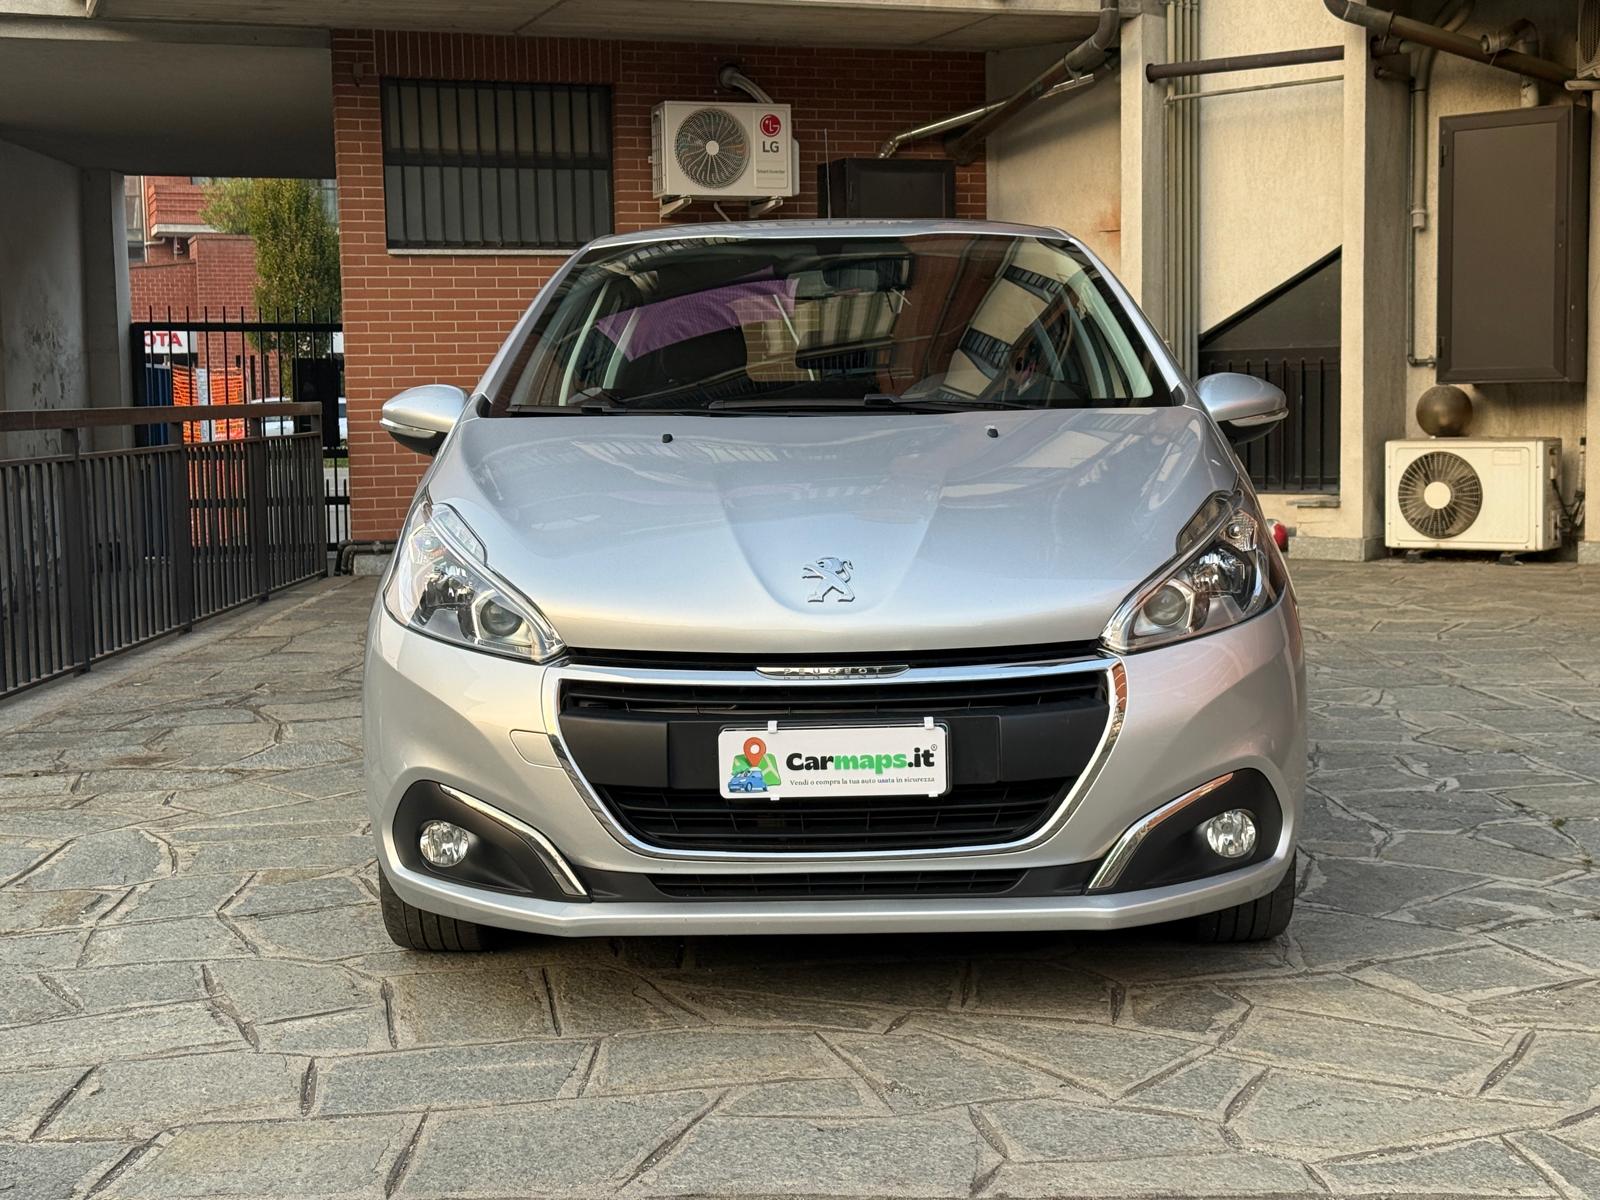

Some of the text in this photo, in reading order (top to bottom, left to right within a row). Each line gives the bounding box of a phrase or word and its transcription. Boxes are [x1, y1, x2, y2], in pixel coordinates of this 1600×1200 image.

[762, 141, 779, 153] LG
[783, 667, 881, 676] PEUGEOT
[815, 779, 841, 787] compra
